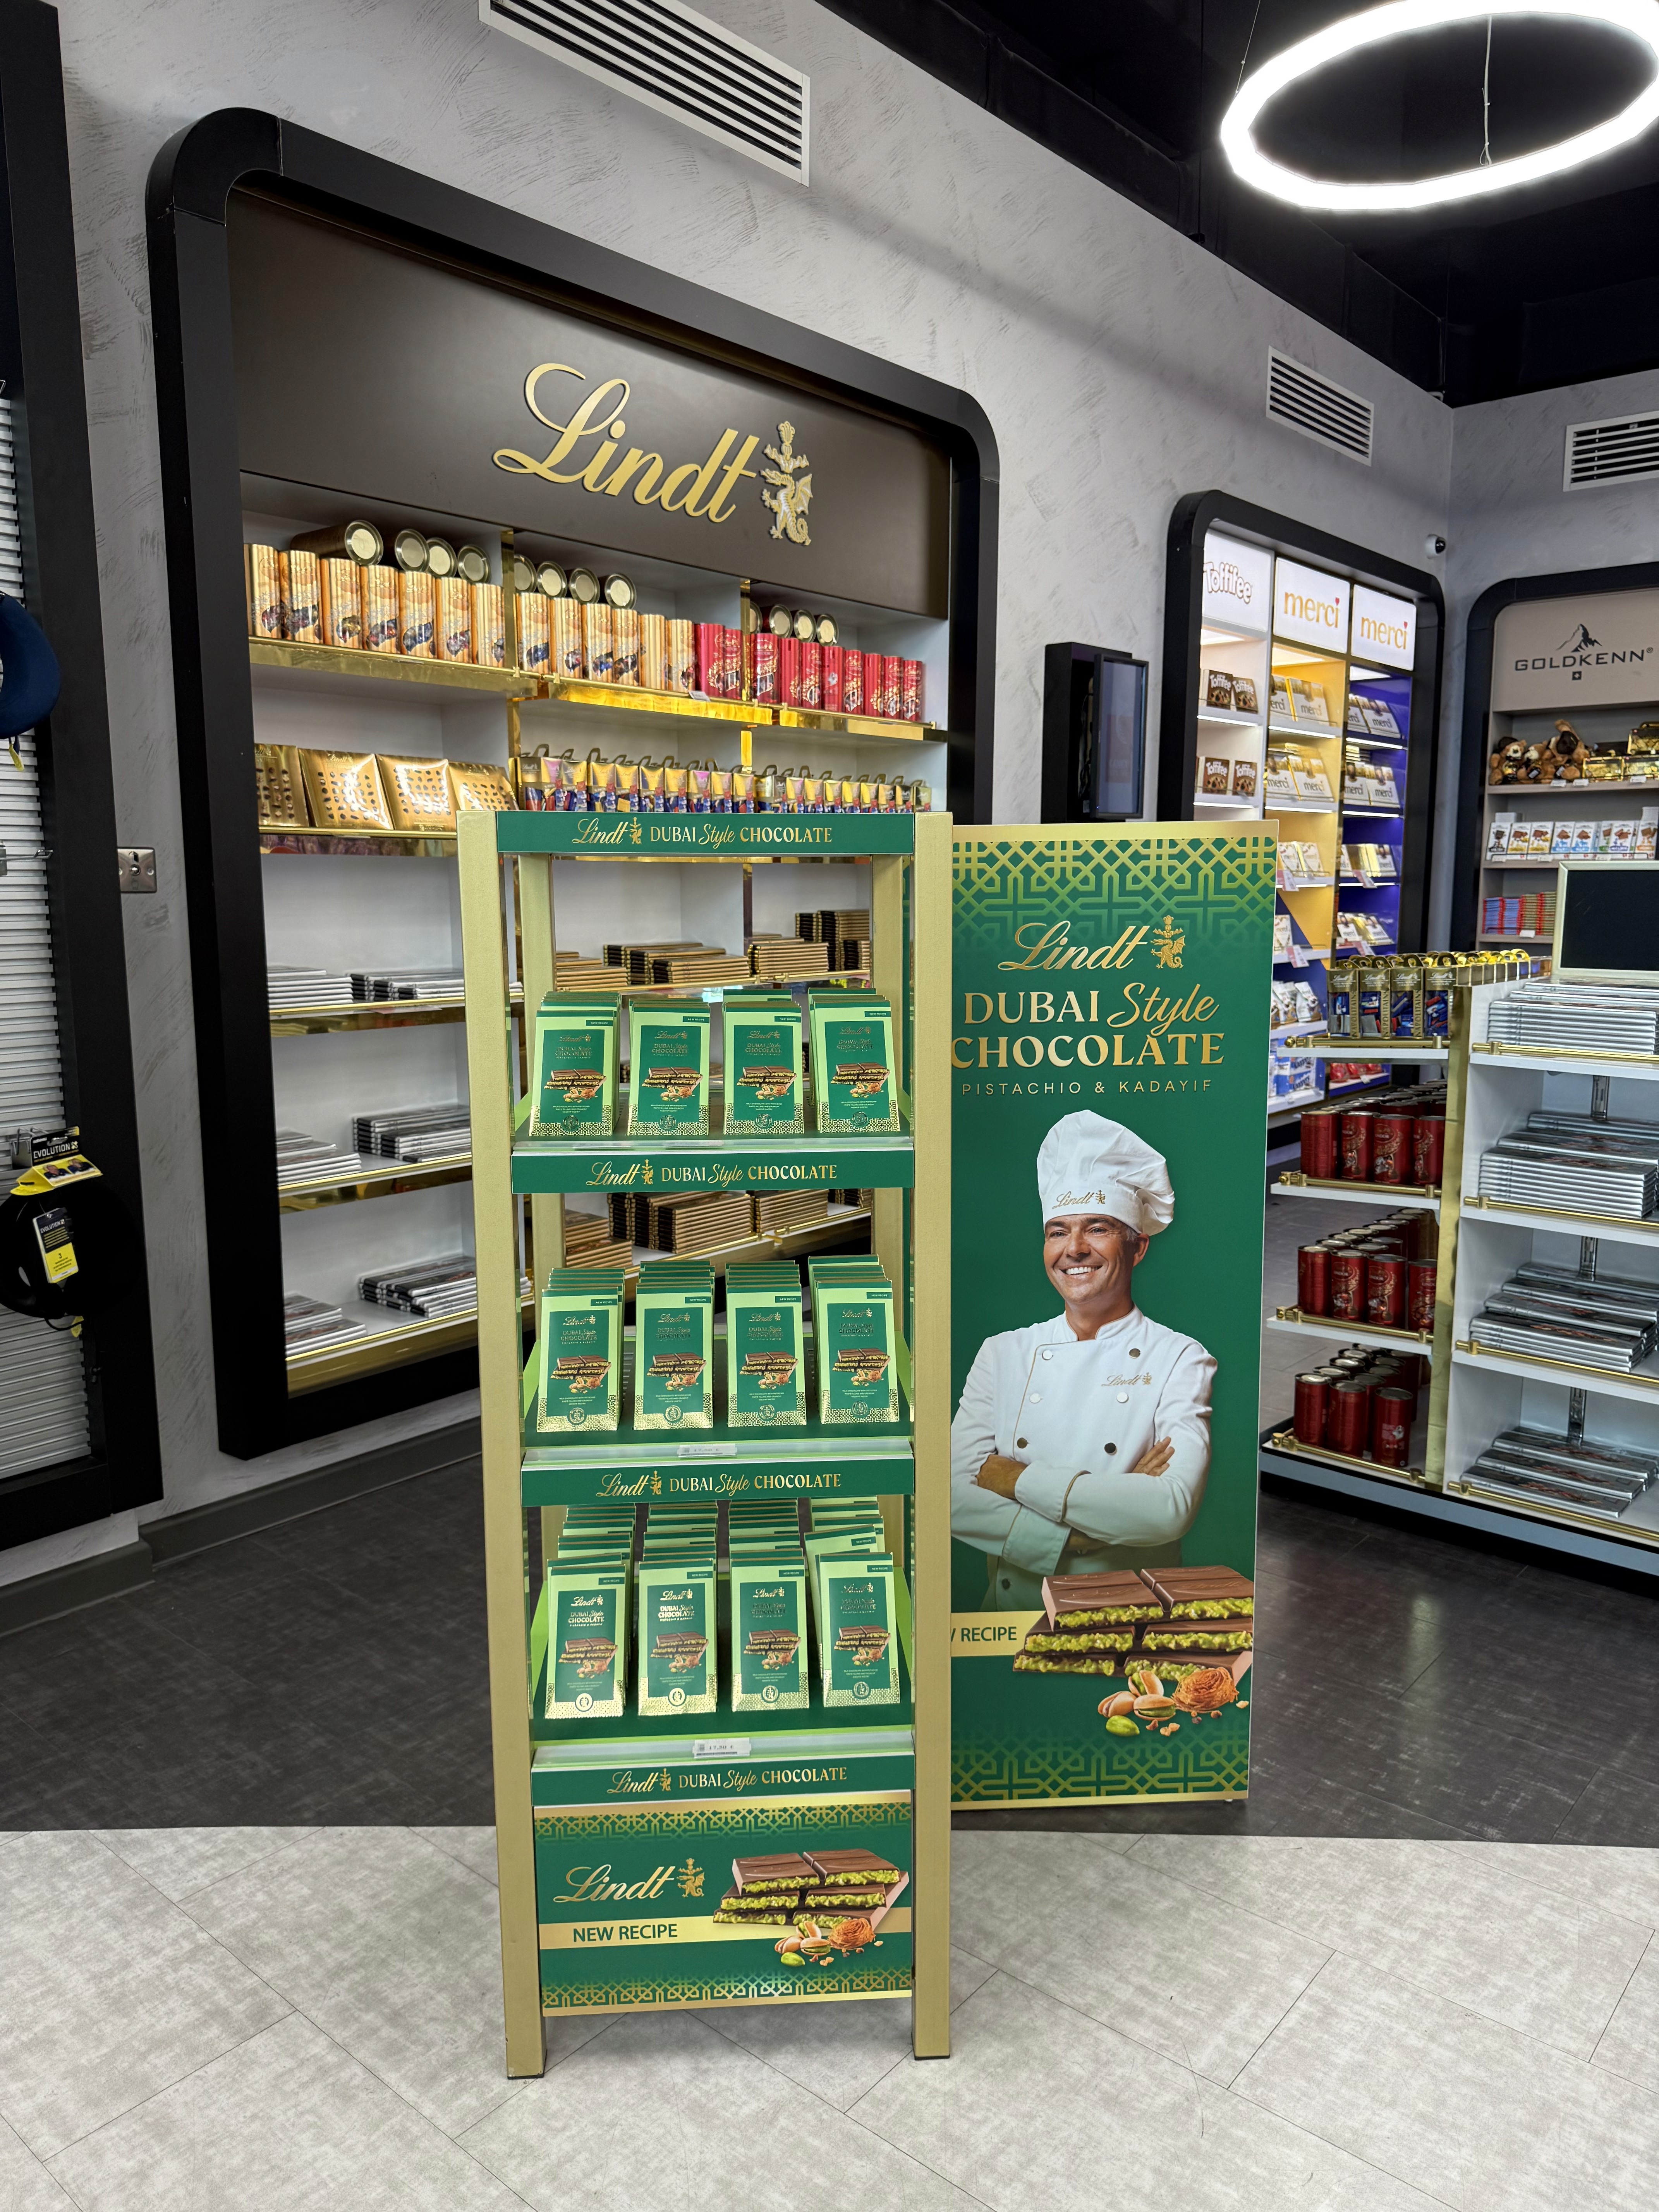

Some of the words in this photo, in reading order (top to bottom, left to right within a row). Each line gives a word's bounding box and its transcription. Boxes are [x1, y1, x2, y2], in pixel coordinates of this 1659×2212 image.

[493, 363, 760, 522] Lindt
[1204, 562, 1252, 604] Toffifee
[1284, 592, 1340, 629] merci
[1360, 616, 1408, 650] merci
[1515, 649, 1644, 672] GOLDKENN
[1210, 674, 1231, 691] Toffifee
[1270, 699, 1285, 710] erci
[1301, 704, 1322, 716] merci
[1372, 718, 1393, 728] merci
[1206, 761, 1227, 777] Toffifee
[1267, 777, 1290, 788] merci
[1304, 781, 1324, 792] merci
[1375, 788, 1393, 798] merci
[572, 818, 628, 845] Lindt
[650, 826, 696, 842] DUBAI
[698, 824, 735, 849] Style
[740, 827, 832, 843] CHOCOLATE
[997, 921, 1150, 970] Lindt
[964, 991, 1099, 1024] DUBAI
[1107, 982, 1219, 1036] Style
[951, 1034, 1224, 1069] CHOCOLATE
[963, 1082, 1080, 1095] PISTACHIO
[1095, 1082, 1104, 1094] &
[1120, 1080, 1211, 1093] KADAYIF
[33, 1142, 70, 1159] EVOLUTION
[586, 1162, 641, 1186] Lindt
[662, 1167, 706, 1182] DUBAI
[708, 1164, 744, 1188] Style
[748, 1165, 837, 1181] CHOCOLATE
[1052, 1191, 1095, 1209] Lindt
[40, 1219, 61, 1234] EVOLUTION
[1101, 1374, 1142, 1387] Lindt
[596, 1473, 649, 1497] Lindt
[670, 1477, 713, 1492] DUBAI
[714, 1474, 750, 1496] Style
[754, 1474, 841, 1489] CHOCOLATE
[571, 1597, 597, 1606] Lindt
[660, 1590, 686, 1601] Lindt
[961, 1626, 1017, 1642] RECIPE
[607, 1771, 658, 1794] Lindt
[679, 1773, 721, 1788] DUBAI
[723, 1770, 758, 1791] Style
[761, 1767, 847, 1784] CHOCOLATE
[553, 1864, 676, 1903] Lindt
[573, 1926, 614, 1942] NEW
[619, 1924, 678, 1940] RECIPE
